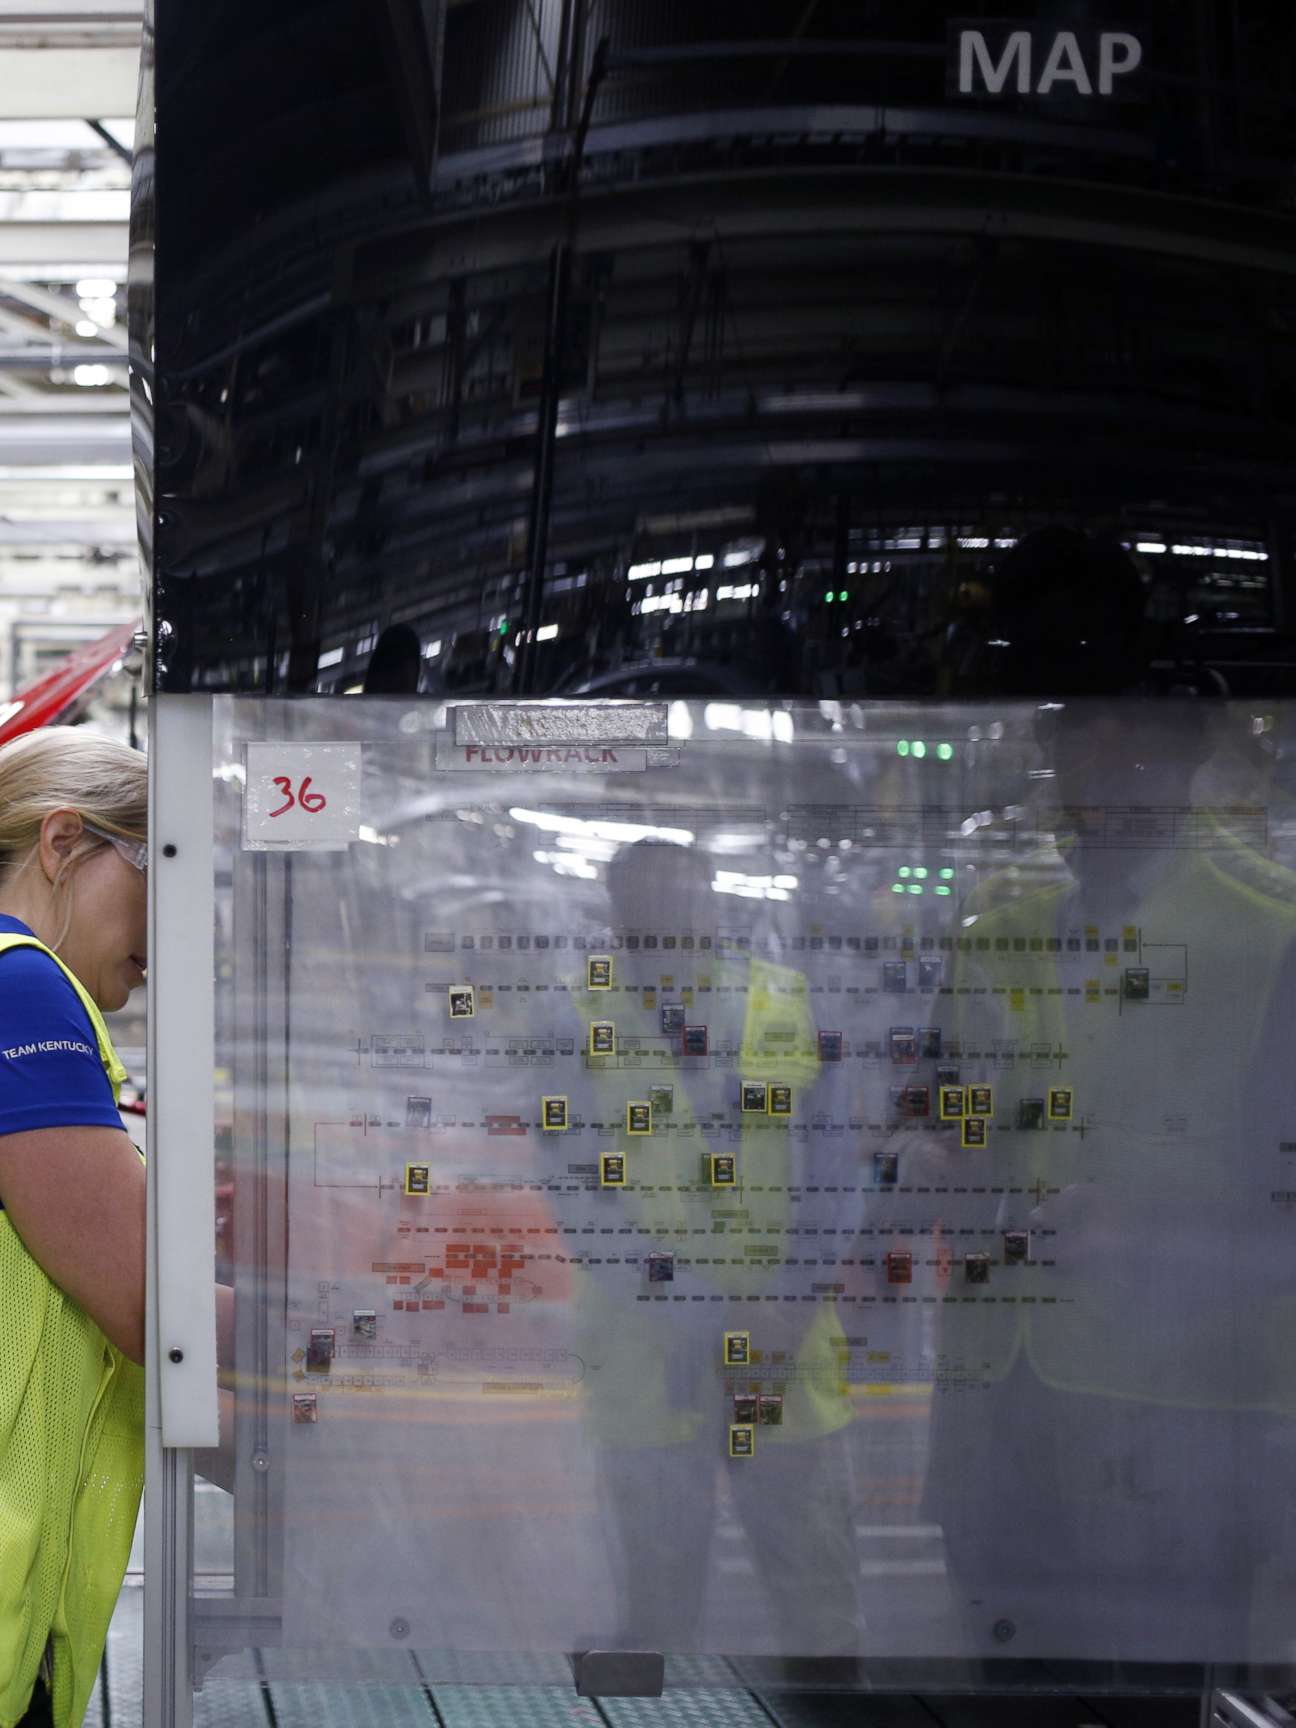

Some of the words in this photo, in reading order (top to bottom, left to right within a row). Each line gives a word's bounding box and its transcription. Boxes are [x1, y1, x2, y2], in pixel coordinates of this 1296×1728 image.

[959, 30, 1143, 96] MAP
[269, 776, 327, 818] 36
[2, 1043, 37, 1060] TEAM
[38, 1040, 94, 1057] KENTUCKY
